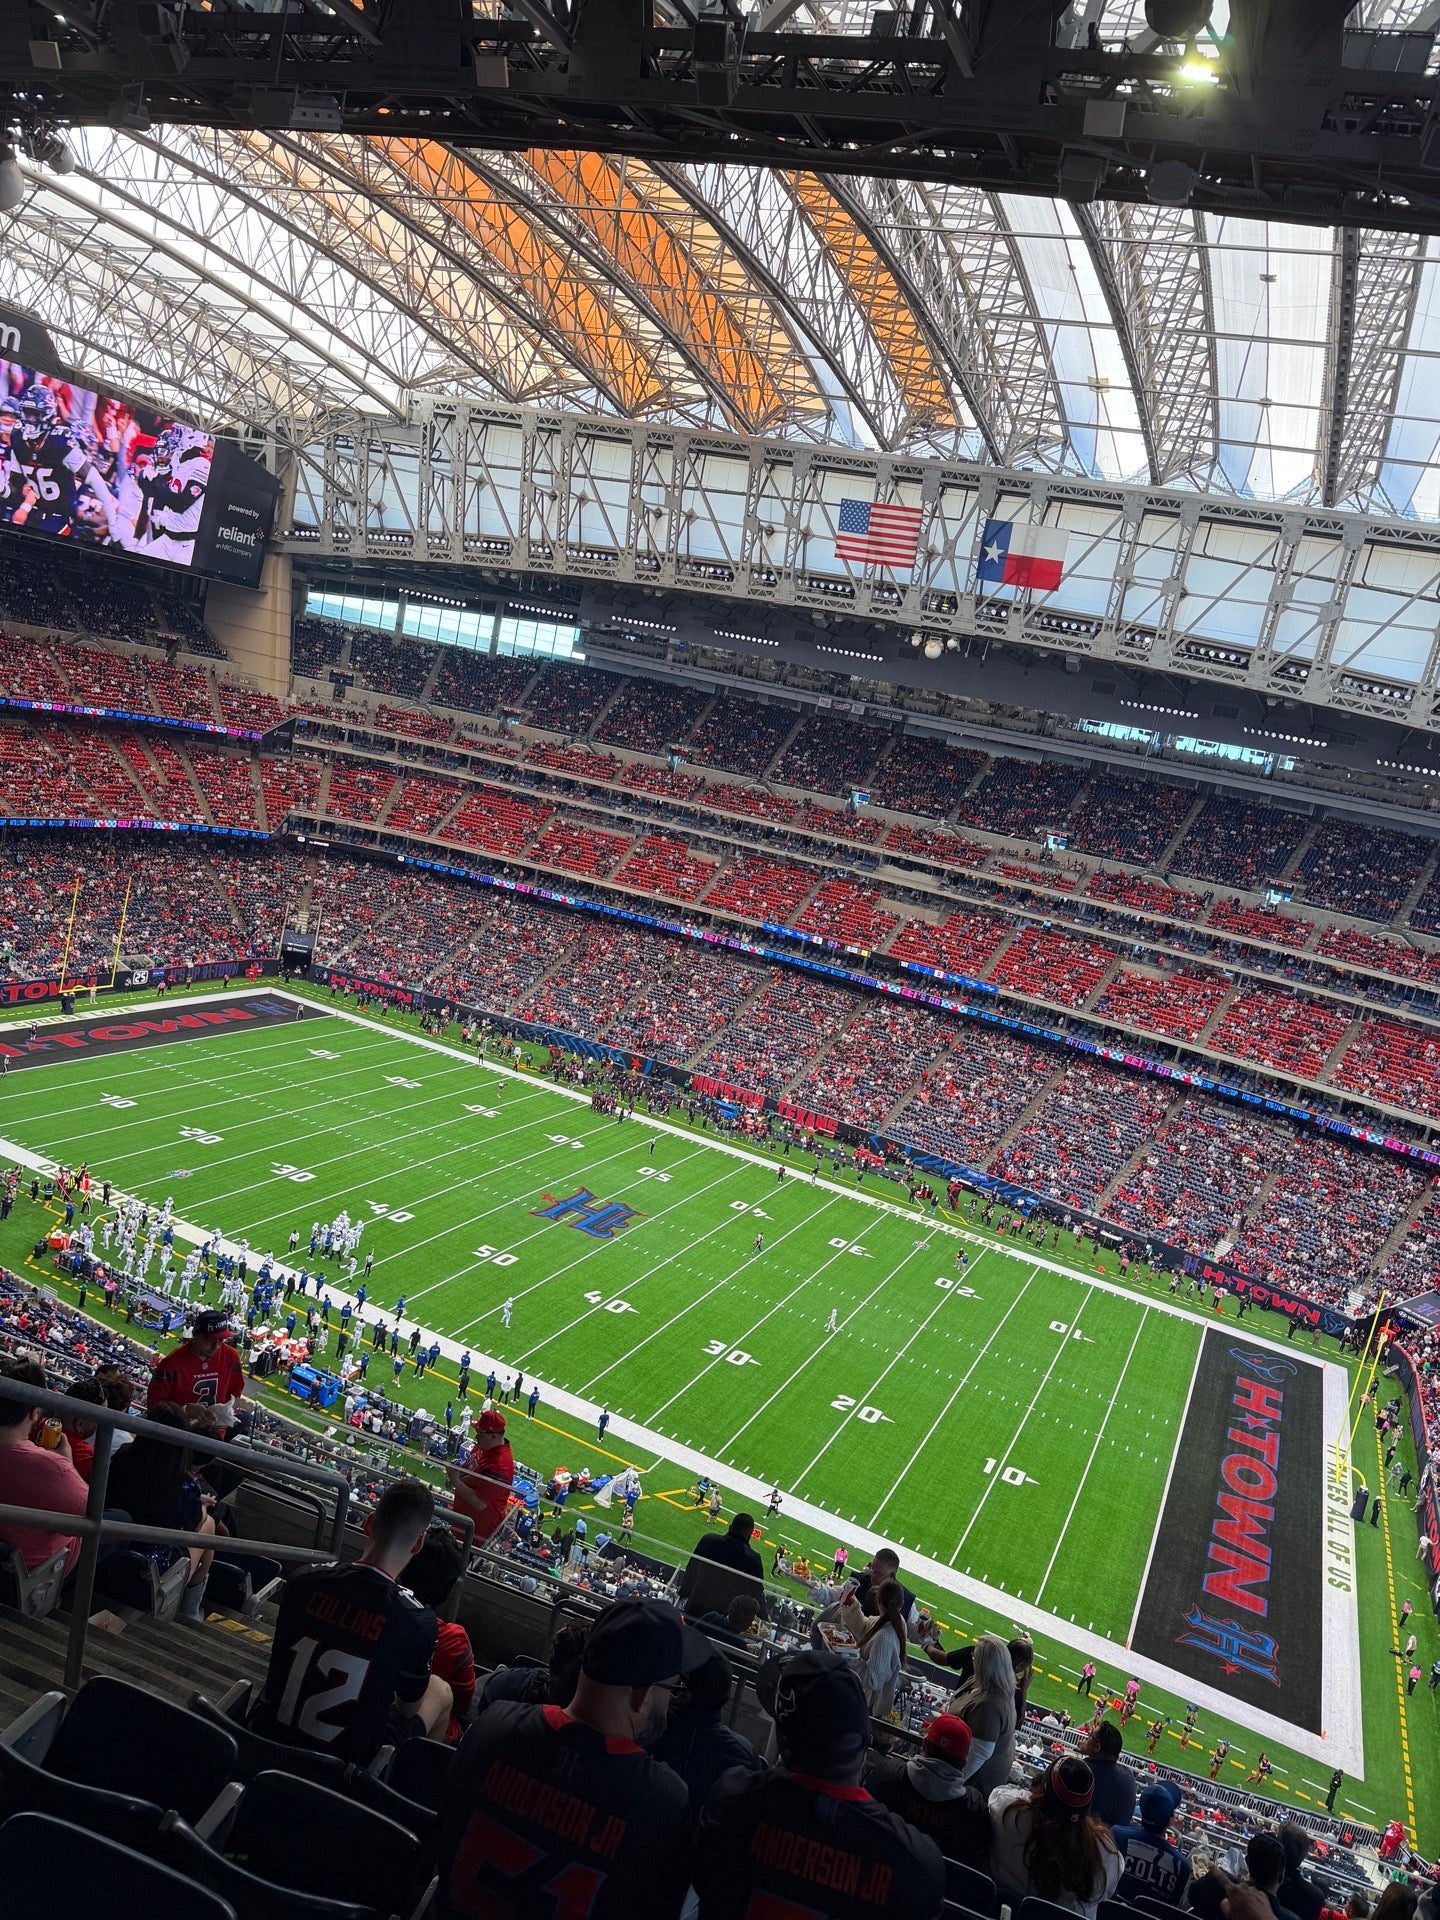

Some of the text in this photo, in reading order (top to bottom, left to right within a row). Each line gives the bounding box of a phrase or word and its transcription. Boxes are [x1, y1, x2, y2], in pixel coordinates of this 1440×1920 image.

[228, 504, 260, 520] powered by
[217, 526, 257, 547] reliant
[233, 547, 252, 559] company
[11, 1006, 136, 1028] CHOOSE LOVE
[692, 1074, 839, 1136] HOUSTON TEXANS
[179, 1126, 224, 1145] 20
[549, 1134, 585, 1150] 40
[270, 1165, 317, 1183] 30
[636, 1166, 674, 1183] 50
[370, 1202, 416, 1223] 40
[729, 1200, 769, 1219] 40
[873, 1199, 1012, 1253] AMERICA 250
[471, 1244, 520, 1267] 50
[828, 1237, 868, 1256] 30
[934, 1277, 976, 1298] 20
[583, 1290, 632, 1314] 40
[1048, 1320, 1083, 1341] 10
[701, 1339, 752, 1366] 30
[830, 1394, 884, 1424] 20
[983, 1457, 1027, 1486] 10
[1327, 1506, 1350, 1536] ALL
[1327, 1541, 1351, 1565] OF
[1327, 1566, 1352, 1593] US
[306, 1590, 386, 1641] COLLINS
[277, 1635, 371, 1743] 12
[481, 1759, 626, 1859] ANDERSON JR
[750, 1822, 893, 1907] ANDERSON JR
[1125, 1855, 1177, 1892] COLTS
